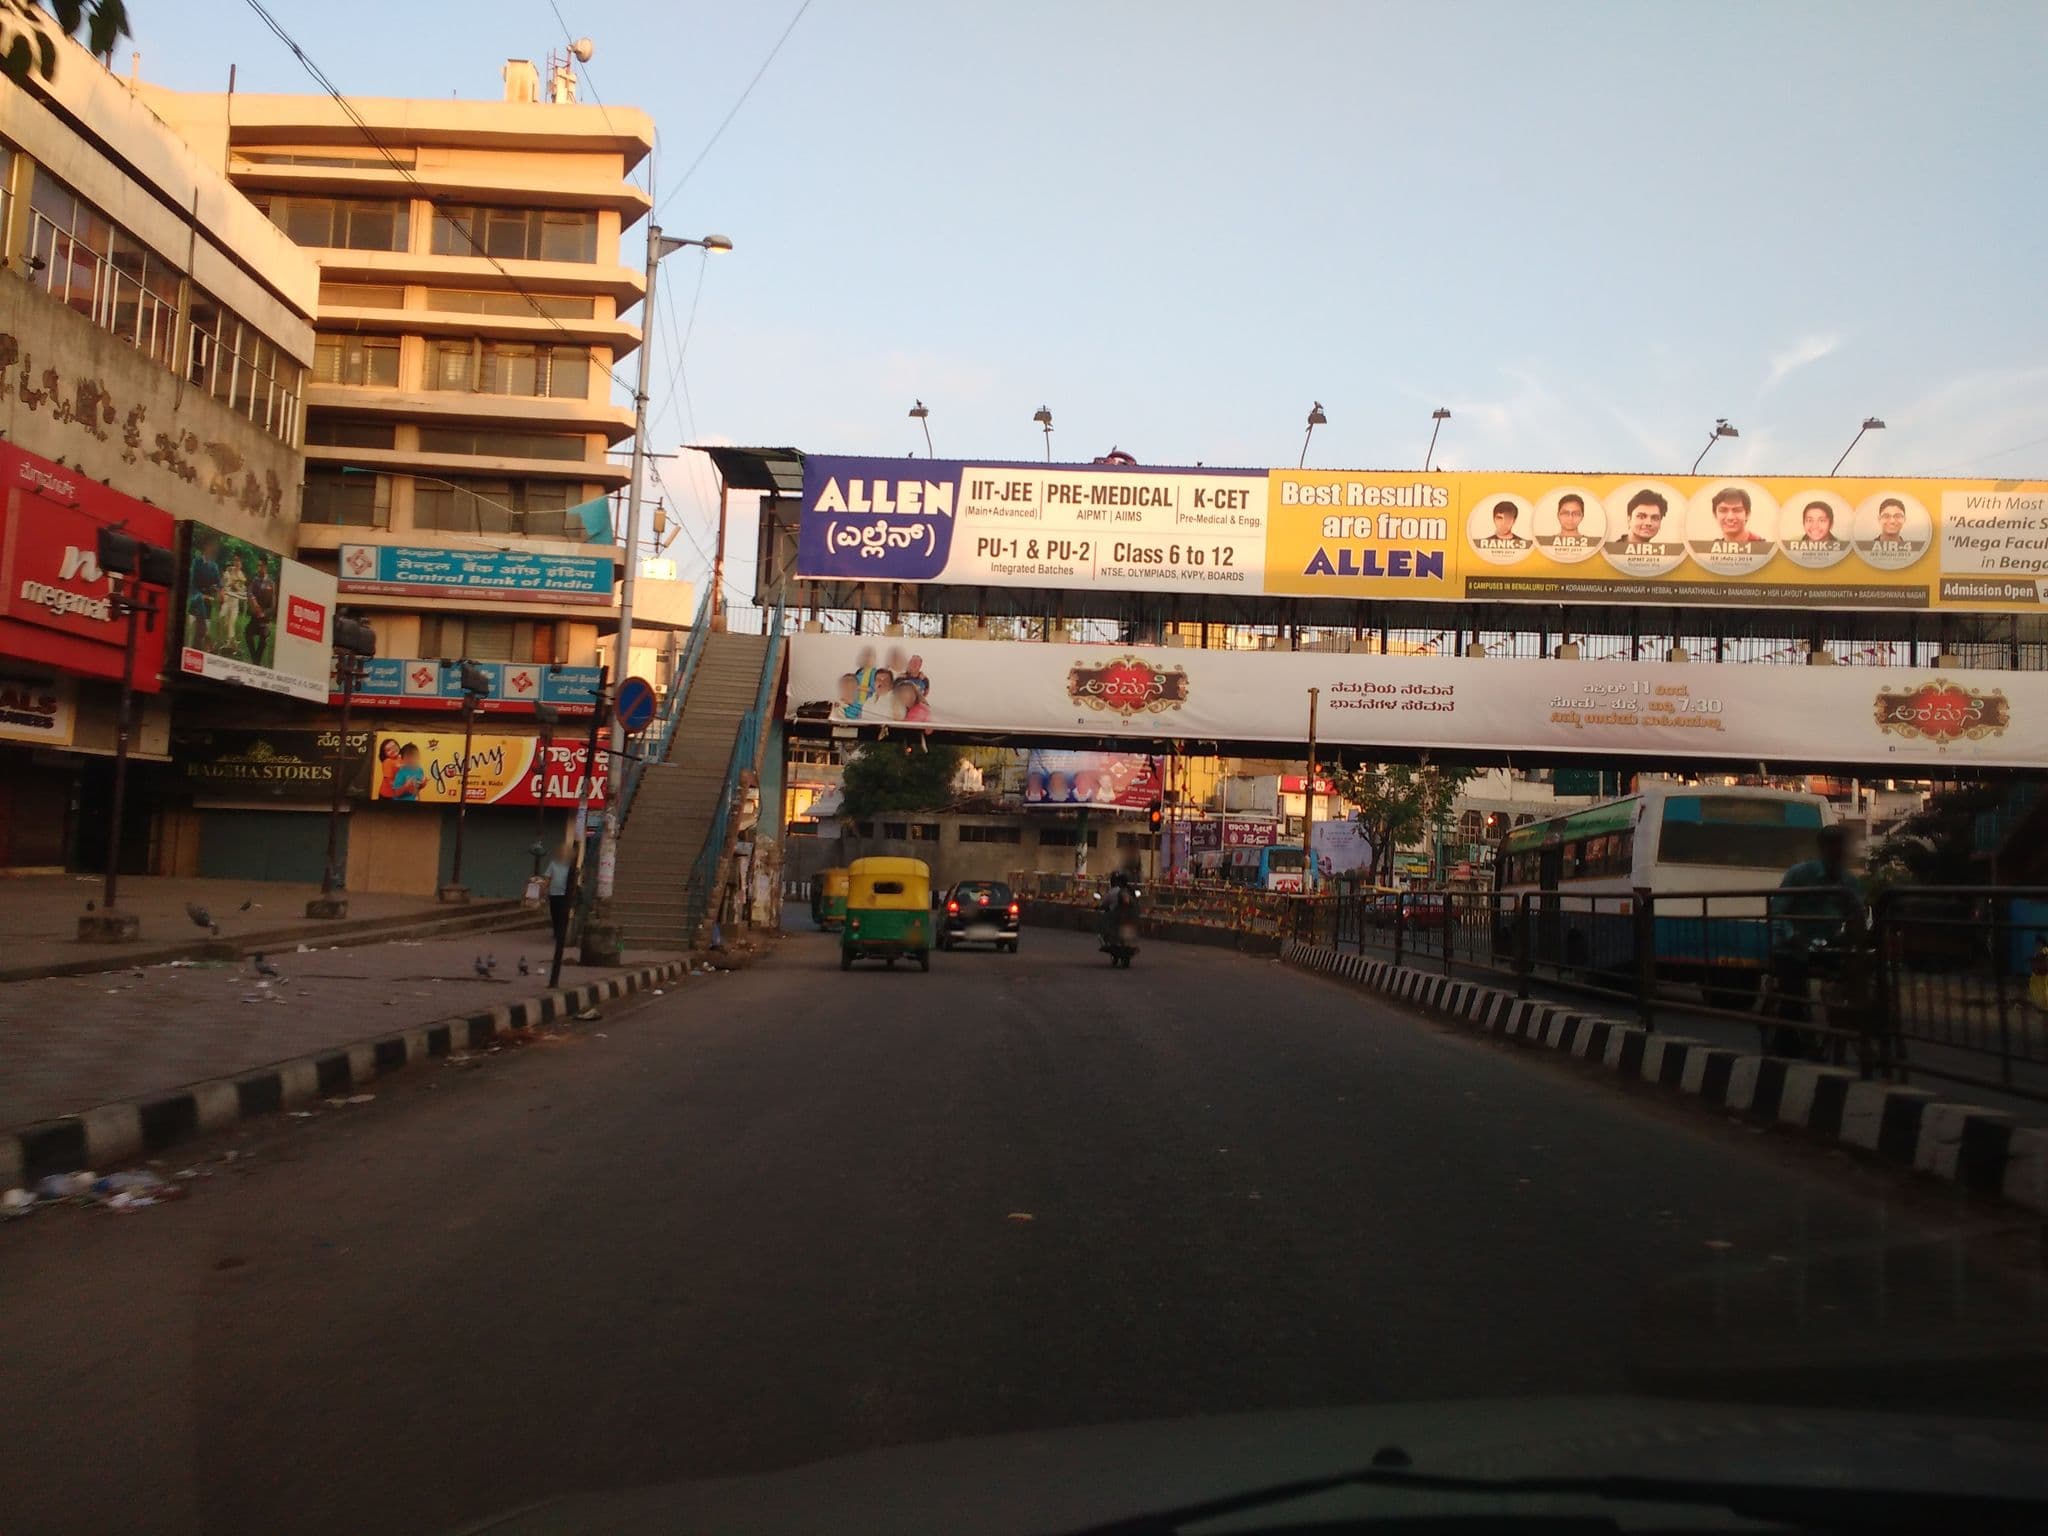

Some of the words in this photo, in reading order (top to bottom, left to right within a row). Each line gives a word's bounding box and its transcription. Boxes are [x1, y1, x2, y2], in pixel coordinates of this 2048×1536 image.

[813, 476, 954, 518] ALLEN
[972, 481, 1033, 502] IIT-JEE
[1047, 484, 1173, 508] PRE-MEDICAL
[1194, 488, 1250, 510] K-CET
[1281, 481, 1342, 506] Best
[1347, 482, 1449, 508] Results
[1967, 496, 2001, 509] With
[2006, 497, 2043, 510] Most
[1076, 510, 1107, 520] AIPMT
[1179, 513, 1227, 525] Pre-Medical
[1230, 515, 1236, 525] &
[1950, 516, 2036, 529] "Academic
[1323, 515, 1372, 539] are
[1377, 513, 1447, 540] from
[1480, 539, 1527, 550] RANK-3
[1553, 536, 1589, 547] AIR-2
[1625, 543, 1667, 555] AIR-1
[1711, 542, 1753, 554] AIR-1
[1790, 541, 1841, 551] RANK-2
[1872, 541, 1913, 552] AIR-4
[1948, 535, 2001, 551] "Mega
[977, 538, 1018, 558] PU-1
[1026, 540, 1040, 560] &
[1047, 541, 1090, 561] PU-2
[1113, 542, 1164, 564] Class
[1169, 544, 1180, 564] 6
[1187, 546, 1204, 565] to
[1212, 547, 1234, 567] 12
[991, 563, 1036, 576] Integrated
[1038, 564, 1075, 576] Batches
[1303, 546, 1445, 581] ALLEN
[1981, 556, 1995, 569] in
[396, 571, 464, 584] Central
[469, 574, 516, 587] Bank
[520, 577, 541, 587] of
[545, 578, 593, 590] India
[1207, 571, 1245, 581] BOARDS
[1944, 583, 2001, 597] Admission
[2004, 584, 2034, 599] Open
[1632, 680, 1650, 695] 11
[1679, 698, 1723, 713] 7:30
[263, 764, 332, 780] STORES
[531, 774, 608, 800] GALAX
